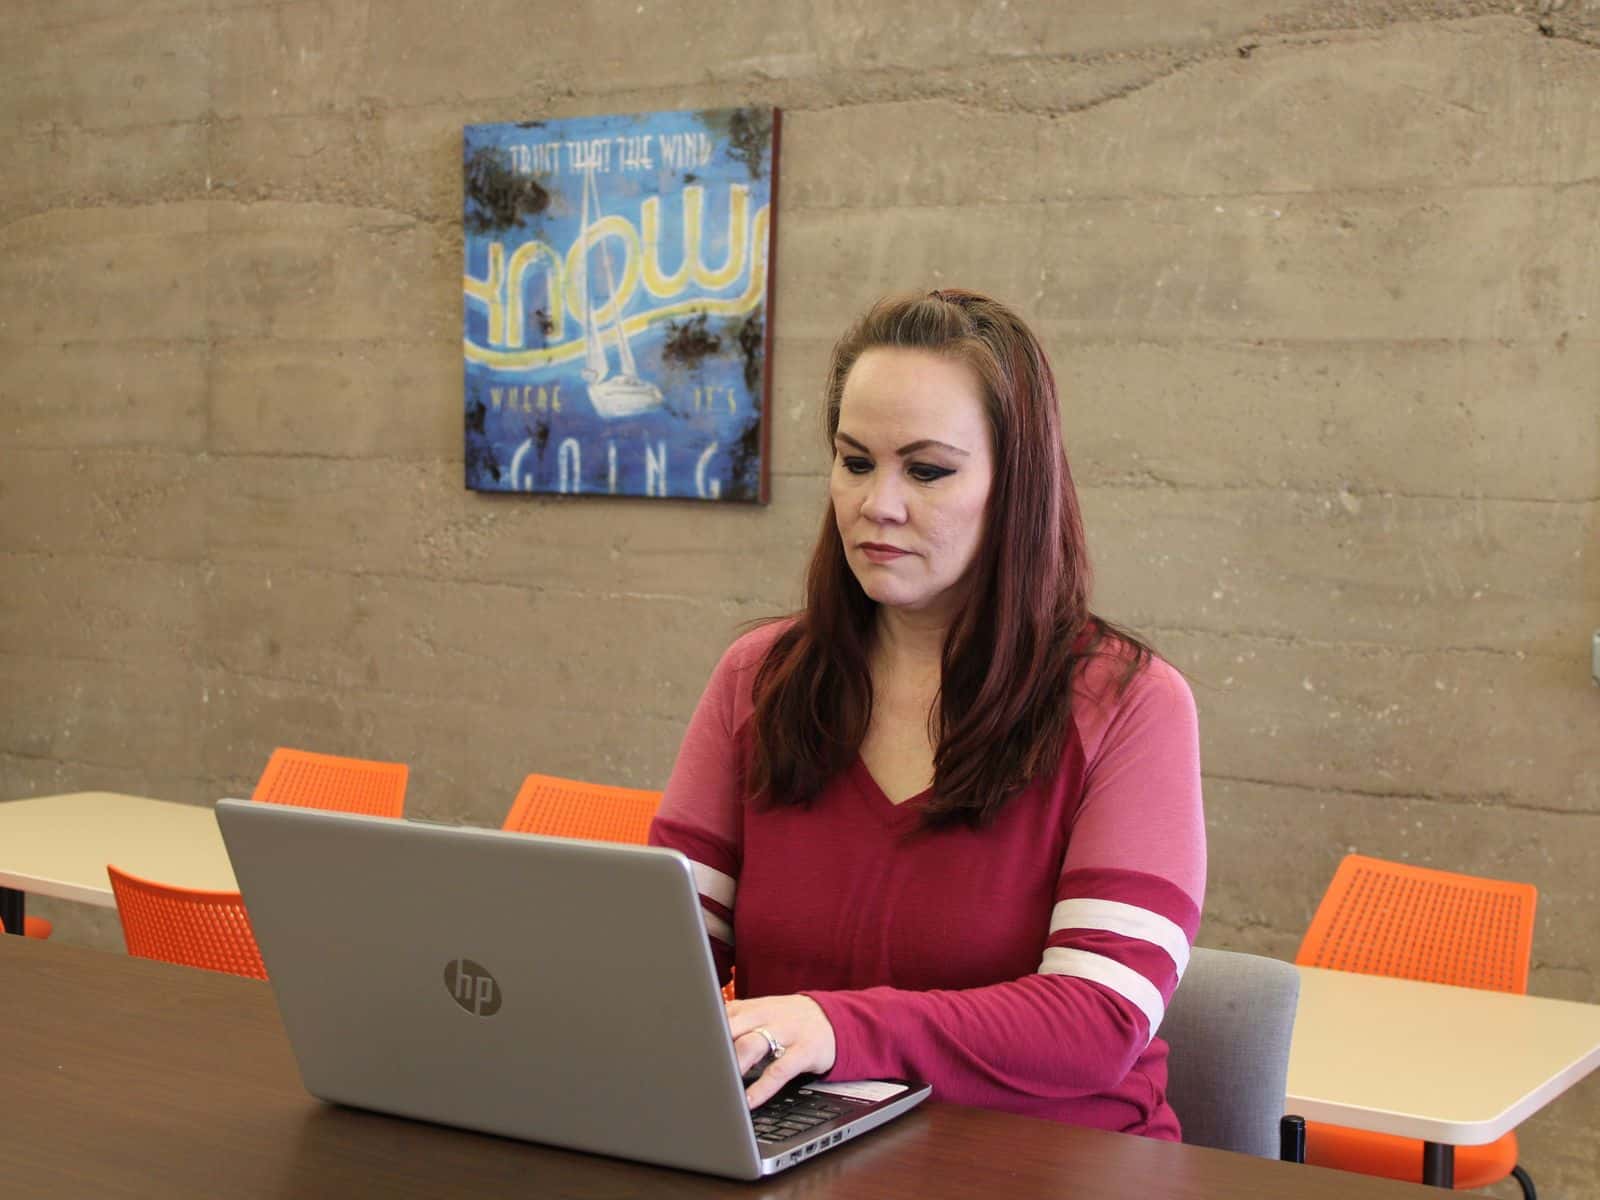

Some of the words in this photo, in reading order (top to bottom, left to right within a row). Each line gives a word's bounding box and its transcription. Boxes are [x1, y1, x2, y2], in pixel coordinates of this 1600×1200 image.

[616, 135, 653, 170] THE
[659, 132, 713, 169] WIND
[510, 438, 721, 499] GOING
[455, 957, 493, 1015] hp
